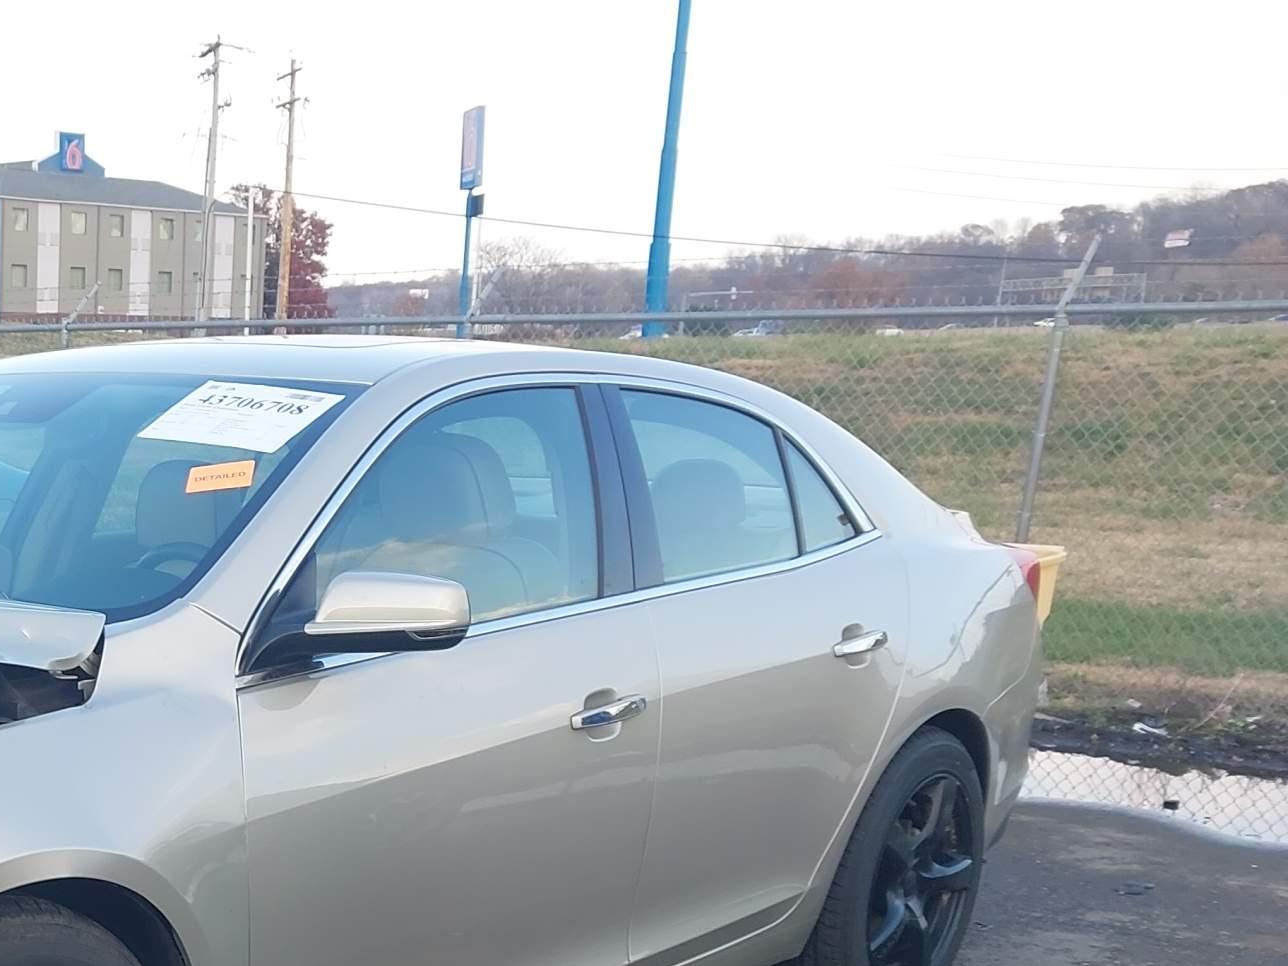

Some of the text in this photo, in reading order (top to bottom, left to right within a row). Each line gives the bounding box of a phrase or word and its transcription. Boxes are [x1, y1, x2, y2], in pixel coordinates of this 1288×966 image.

[66, 138, 82, 170] 6
[199, 393, 310, 416] 43706708
[194, 471, 247, 482] DETAILED
